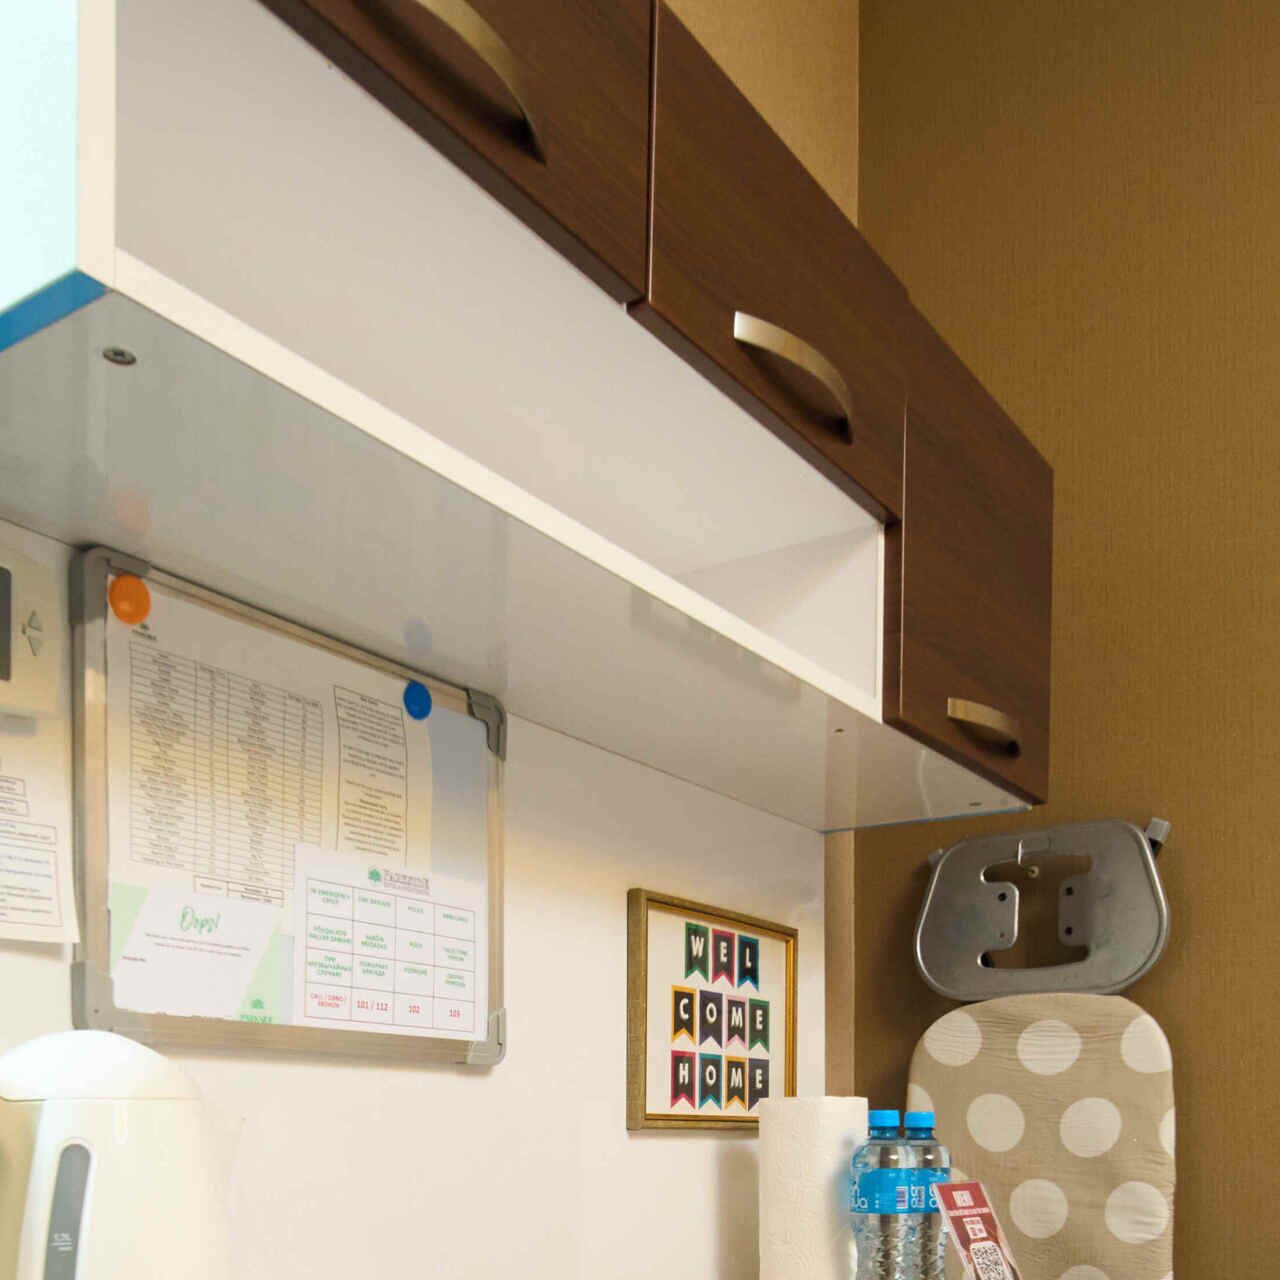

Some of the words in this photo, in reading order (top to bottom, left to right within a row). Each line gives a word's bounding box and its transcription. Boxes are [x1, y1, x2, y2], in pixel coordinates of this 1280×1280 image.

[690, 935, 752, 968] WEL
[679, 998, 763, 1030] COME
[678, 1063, 763, 1090] HOME
